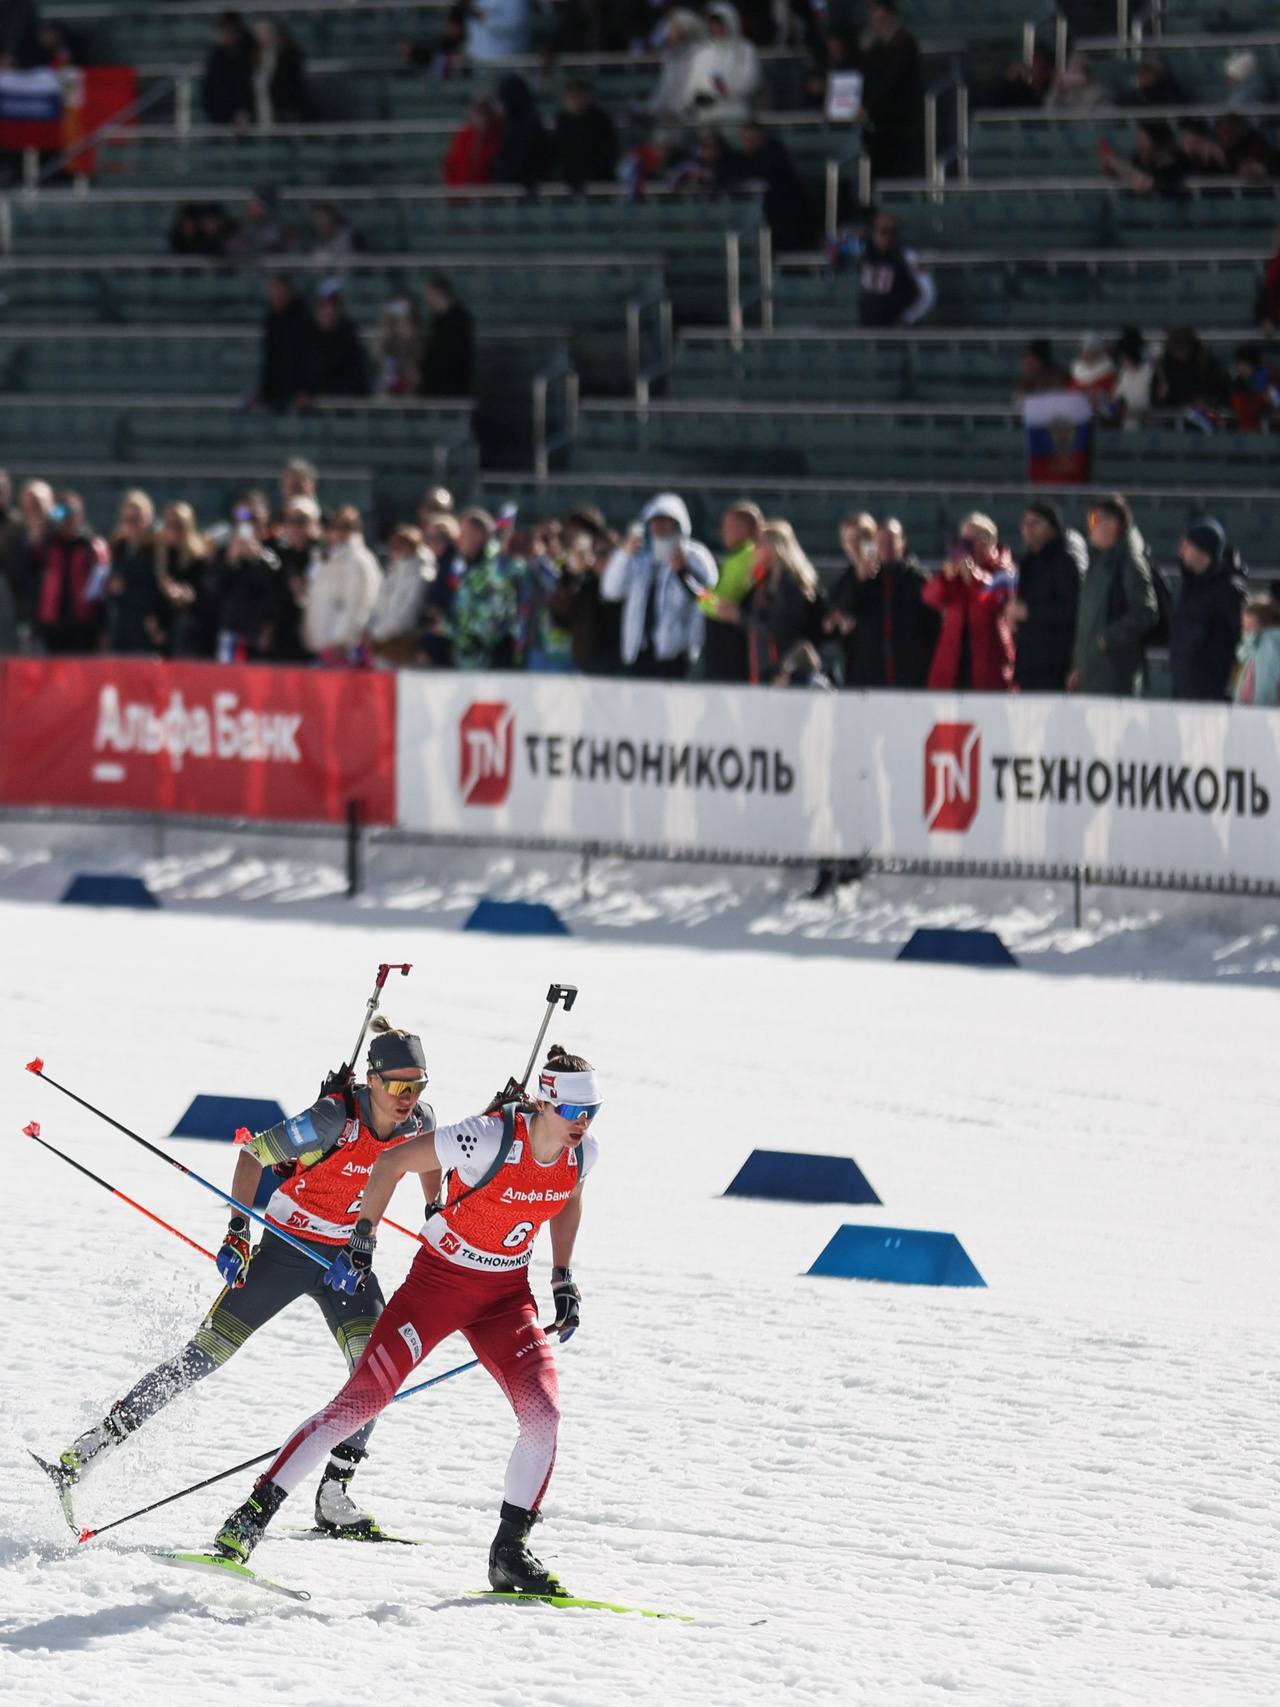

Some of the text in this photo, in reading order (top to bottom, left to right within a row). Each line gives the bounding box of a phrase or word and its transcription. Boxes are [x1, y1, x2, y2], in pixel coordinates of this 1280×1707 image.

[93, 684, 302, 778] Альфа Банк
[991, 754, 1272, 819] ТЕХНОНИКОЛЬ
[341, 1161, 374, 1177] Альф
[500, 1186, 572, 1204] Альфа Банк
[501, 1220, 535, 1248] 6
